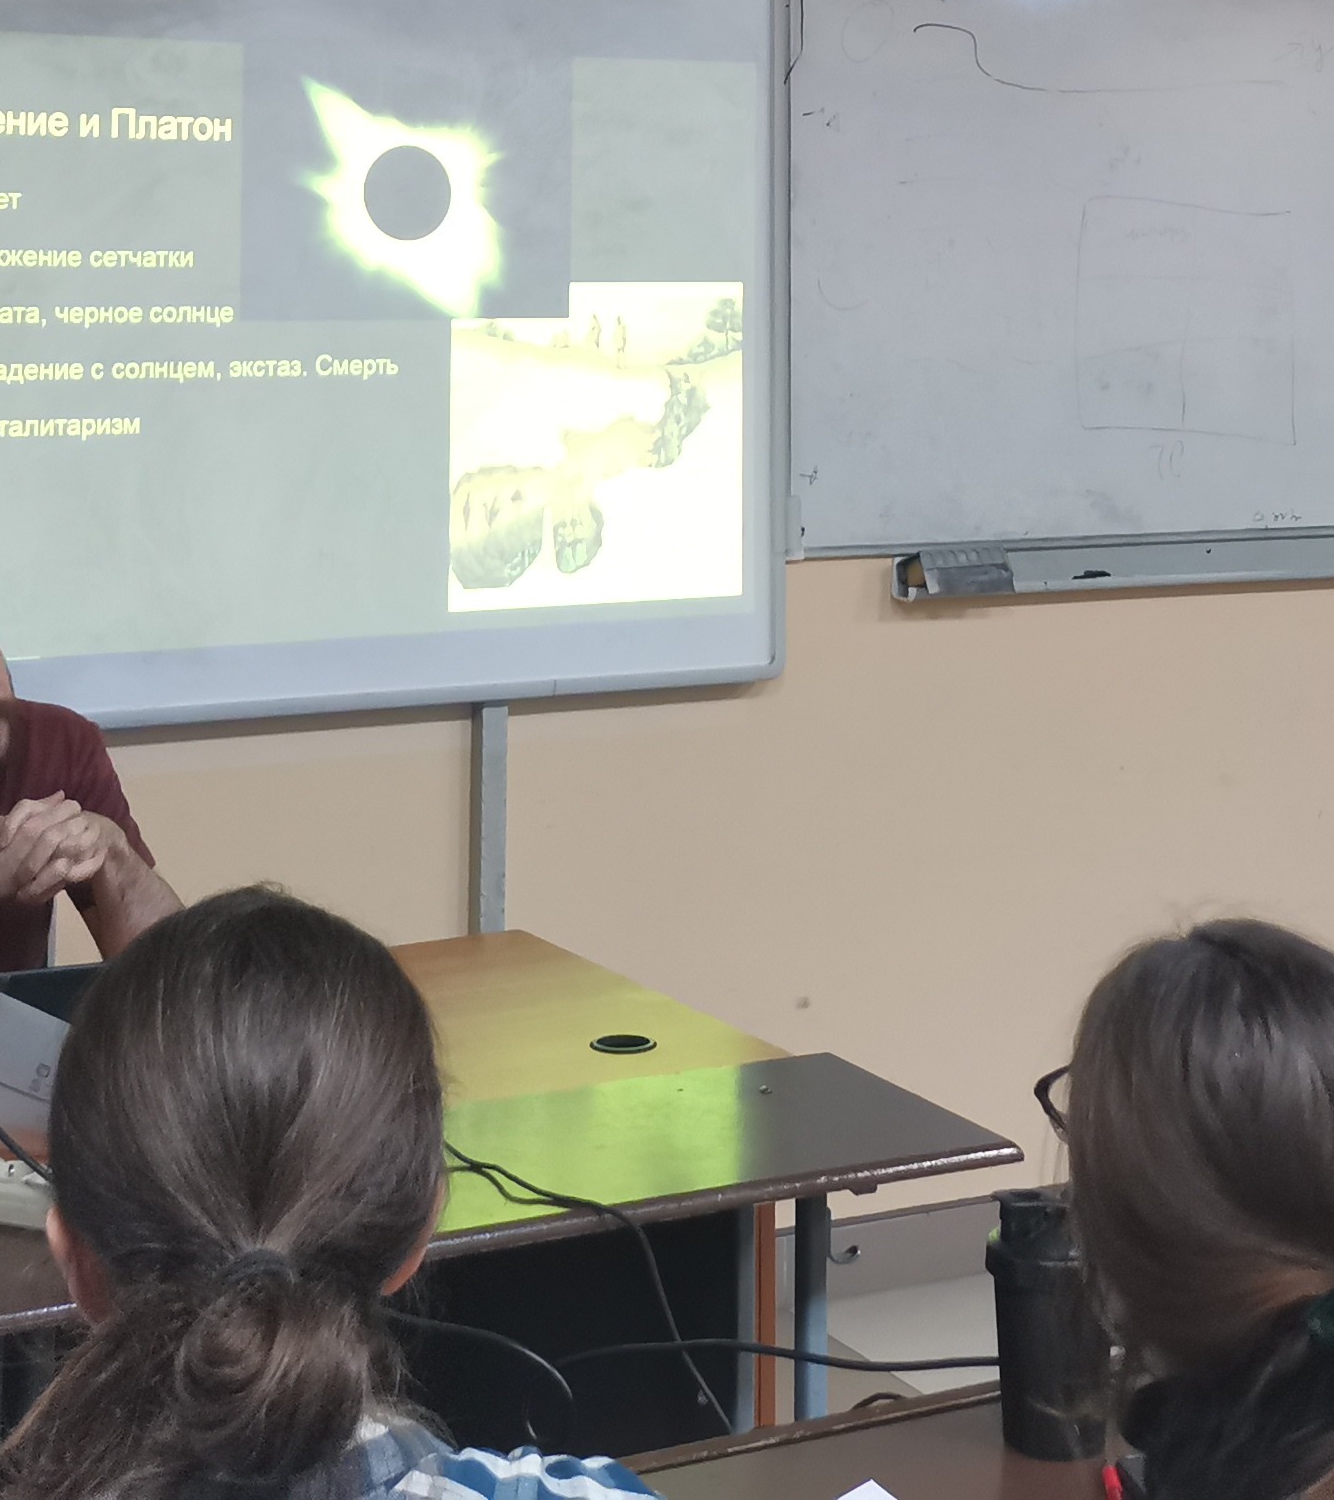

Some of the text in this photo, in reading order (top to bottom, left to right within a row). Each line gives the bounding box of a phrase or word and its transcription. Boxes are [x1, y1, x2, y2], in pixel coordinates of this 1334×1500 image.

[79, 113, 100, 139] и
[110, 107, 233, 142] Платон
[89, 248, 194, 268] сетчатки
[54, 304, 143, 329] черное
[149, 304, 234, 328] солнце
[91, 362, 104, 380] с
[111, 360, 221, 383] солнцем,
[229, 359, 308, 377] экстаз.
[315, 354, 399, 380] Смерть
